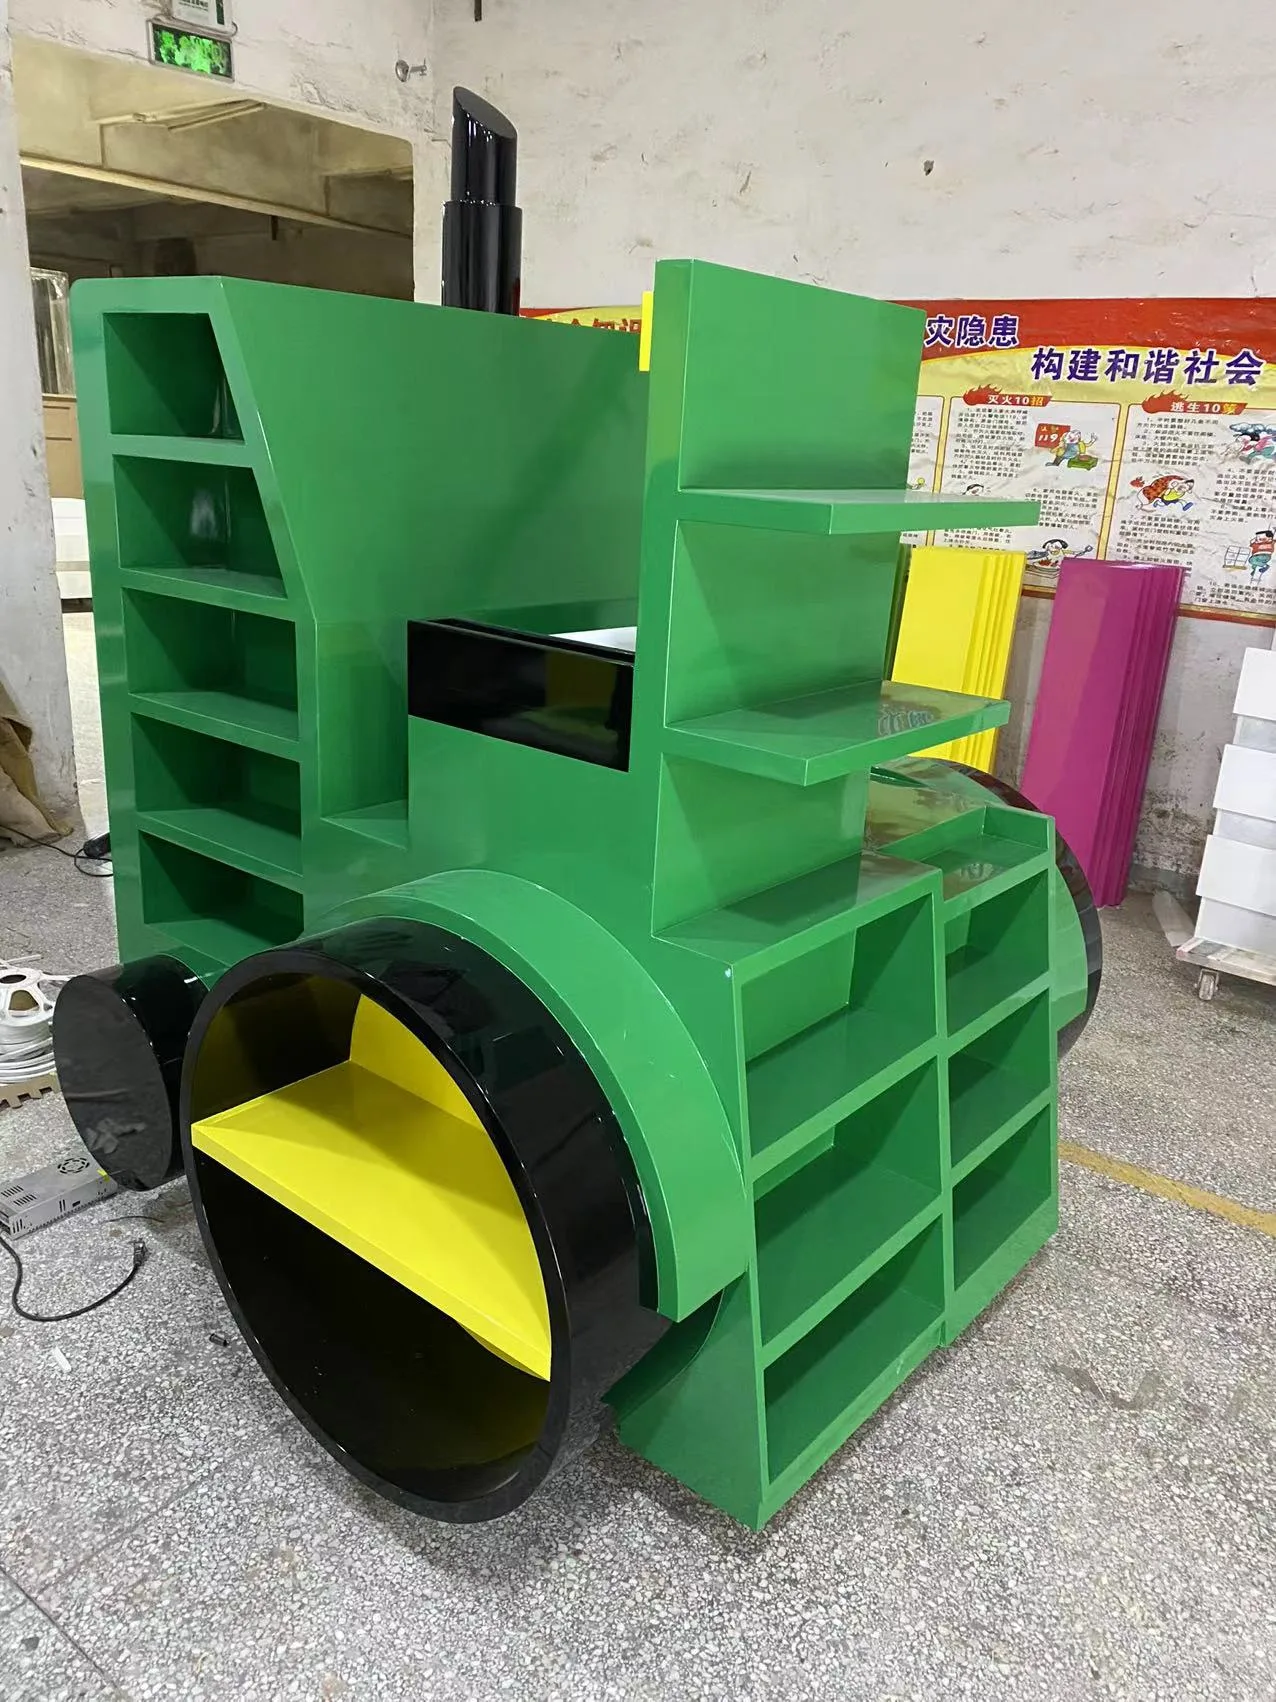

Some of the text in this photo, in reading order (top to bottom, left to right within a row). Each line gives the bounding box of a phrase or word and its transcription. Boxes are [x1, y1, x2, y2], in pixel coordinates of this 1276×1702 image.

[924, 315, 1020, 347] 灾隐患
[1031, 347, 1267, 386] 构建和谐社会
[987, 395, 1044, 406] 灭火10招
[1038, 433, 1058, 447] 119
